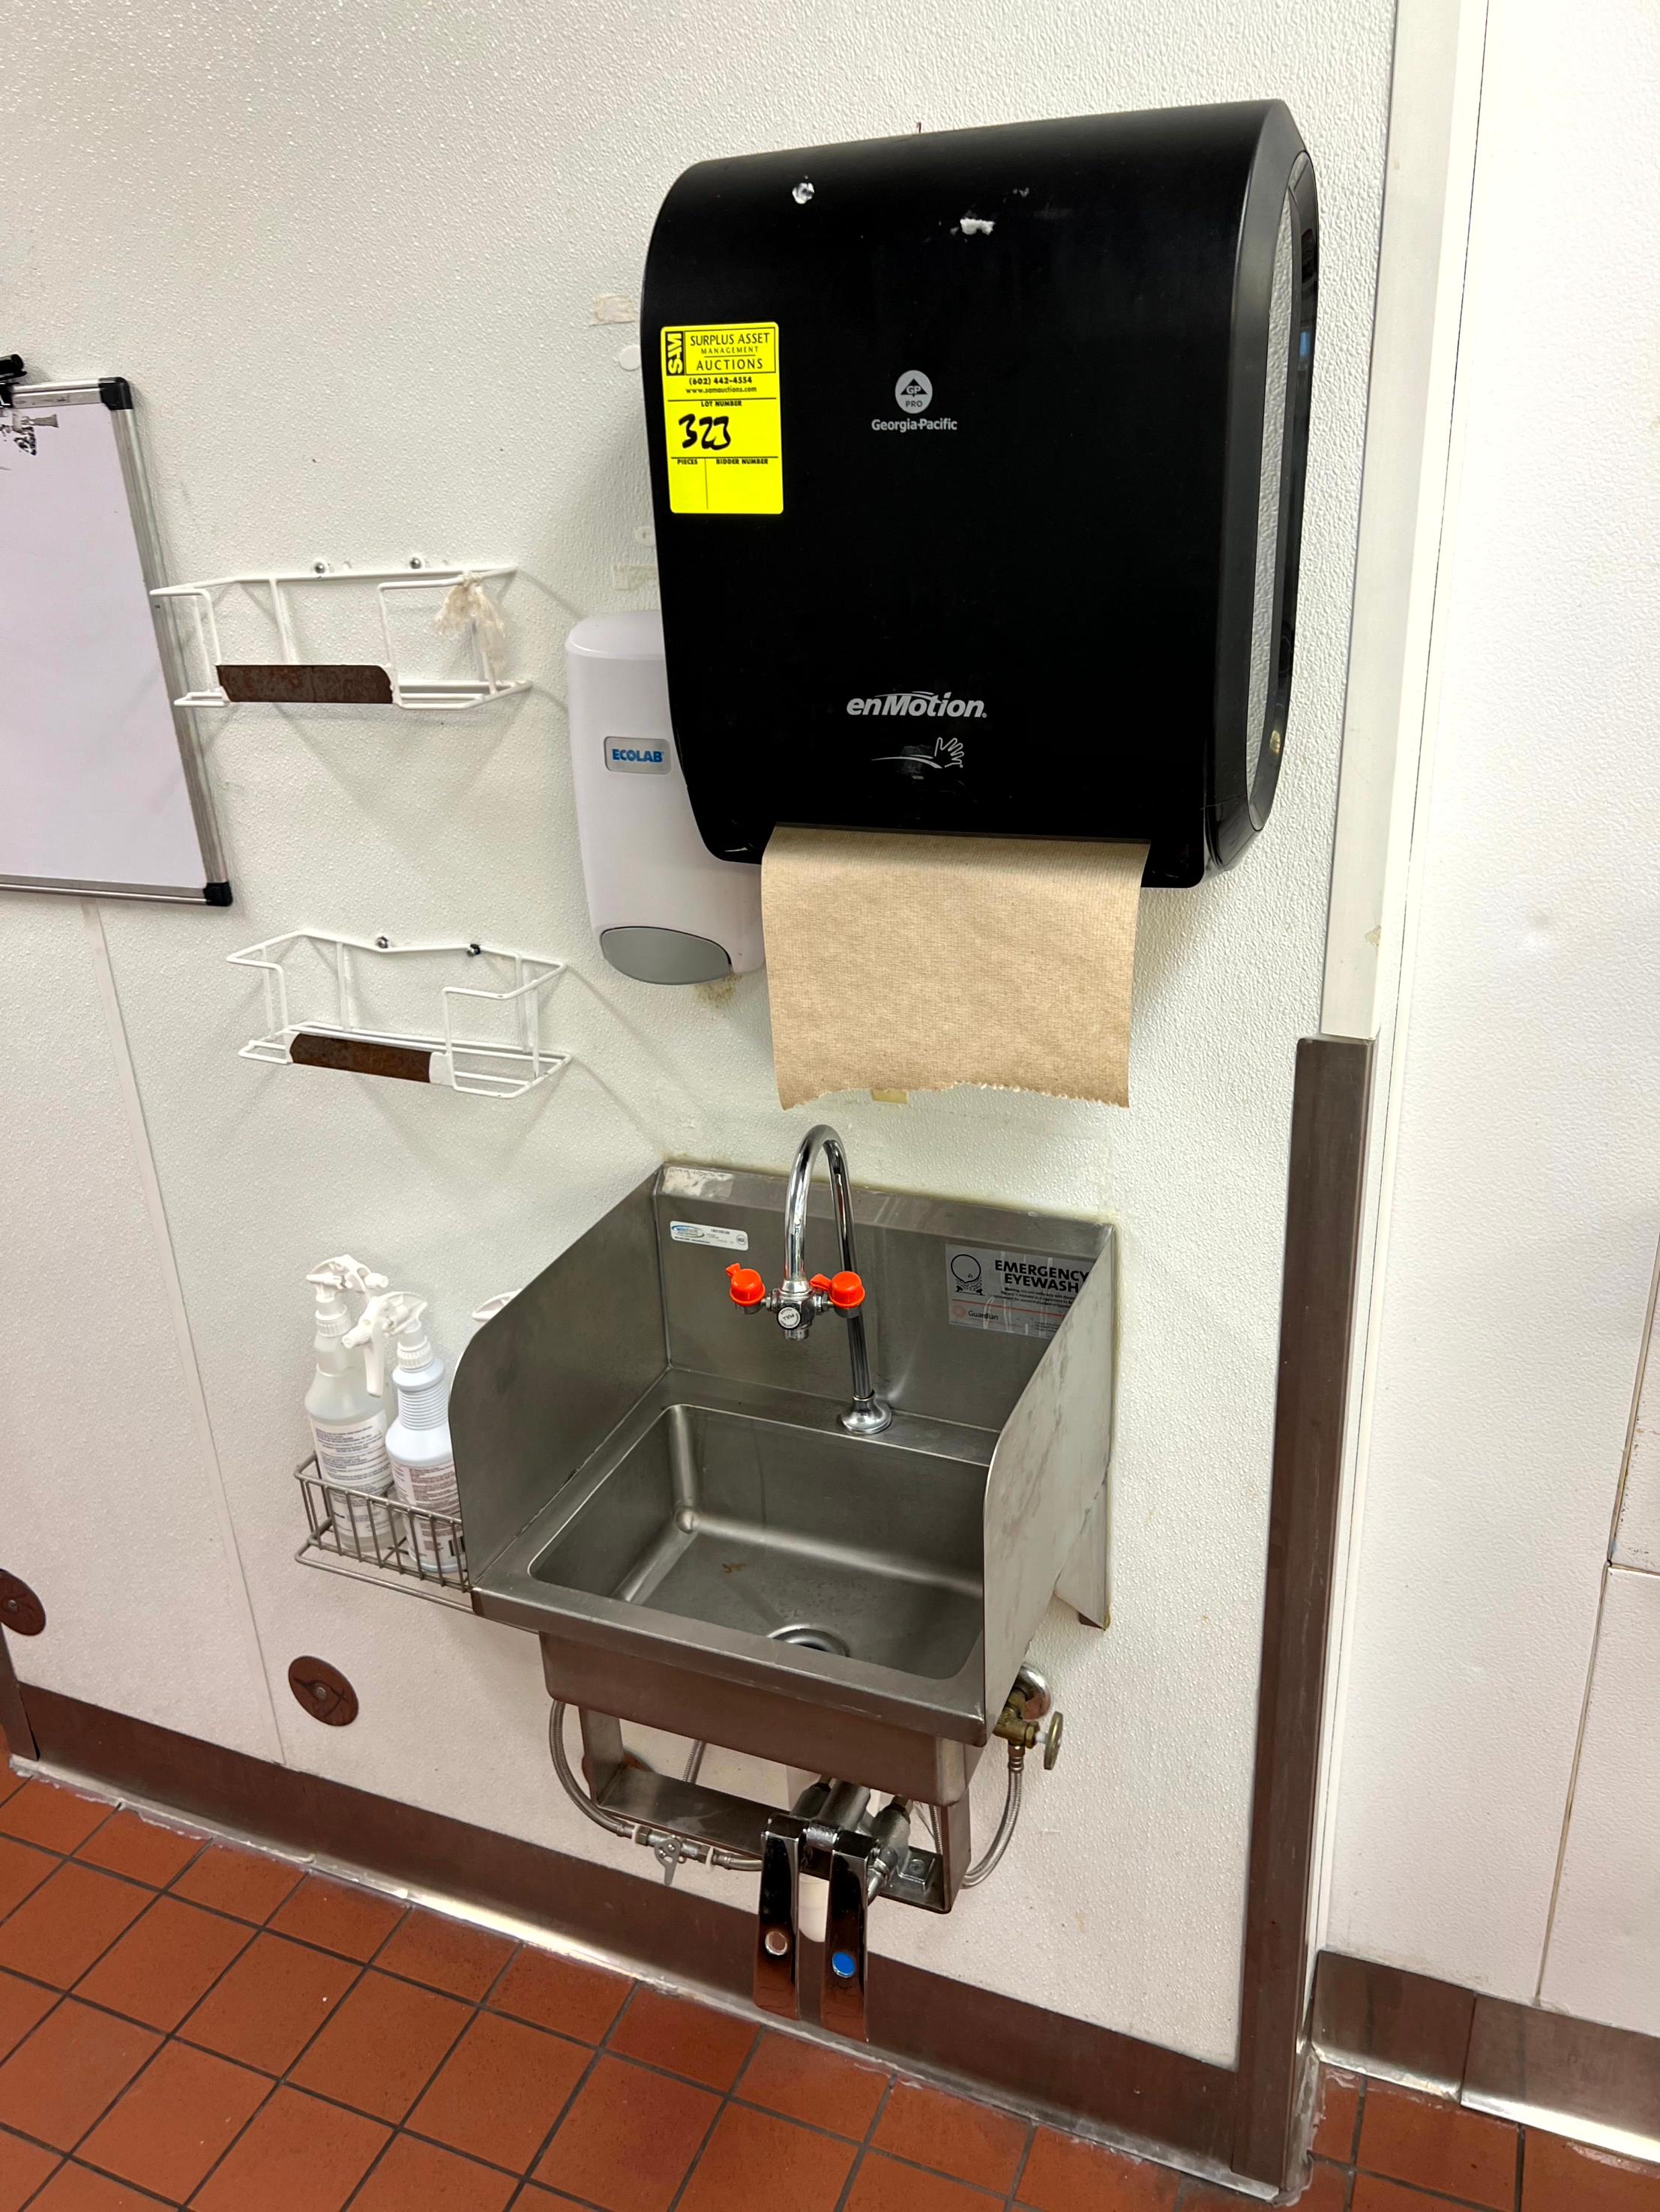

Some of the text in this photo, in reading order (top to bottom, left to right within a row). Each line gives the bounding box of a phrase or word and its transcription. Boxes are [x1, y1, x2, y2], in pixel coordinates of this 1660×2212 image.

[691, 332, 770, 346] SURPLUS ASSET
[697, 358, 763, 371] AUCTIONS
[689, 376, 712, 385] (602)
[685, 386, 757, 394] www.samauctions.com
[906, 385, 921, 395] GP
[679, 413, 732, 450] 323
[871, 418, 957, 433] Georgia-Pacific
[612, 749, 663, 762] ECOLAB
[995, 1259, 1089, 1283] EMERGENCY
[1005, 1273, 1079, 1293] EYEWASH
[968, 1310, 999, 1320] Guardian
